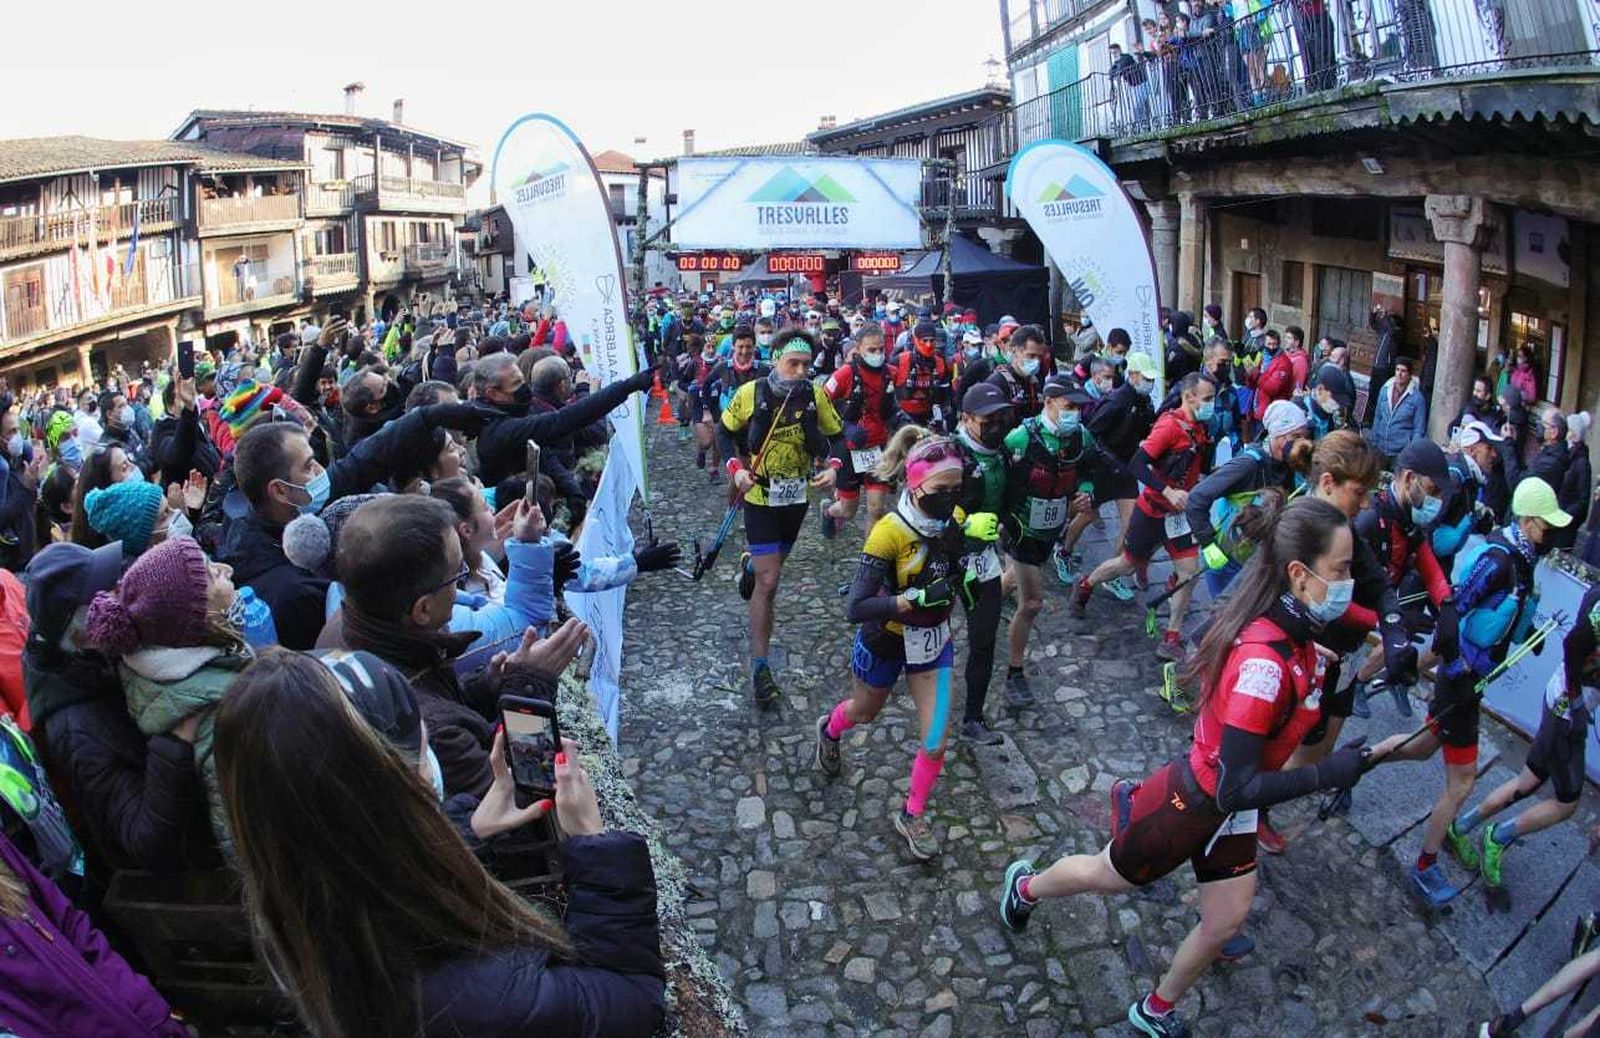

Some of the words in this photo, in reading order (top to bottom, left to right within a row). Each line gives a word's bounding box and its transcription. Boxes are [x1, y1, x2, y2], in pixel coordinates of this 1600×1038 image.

[757, 206, 849, 225] TRESVALLES
[777, 484, 799, 499] 262
[1044, 506, 1059, 521] 68
